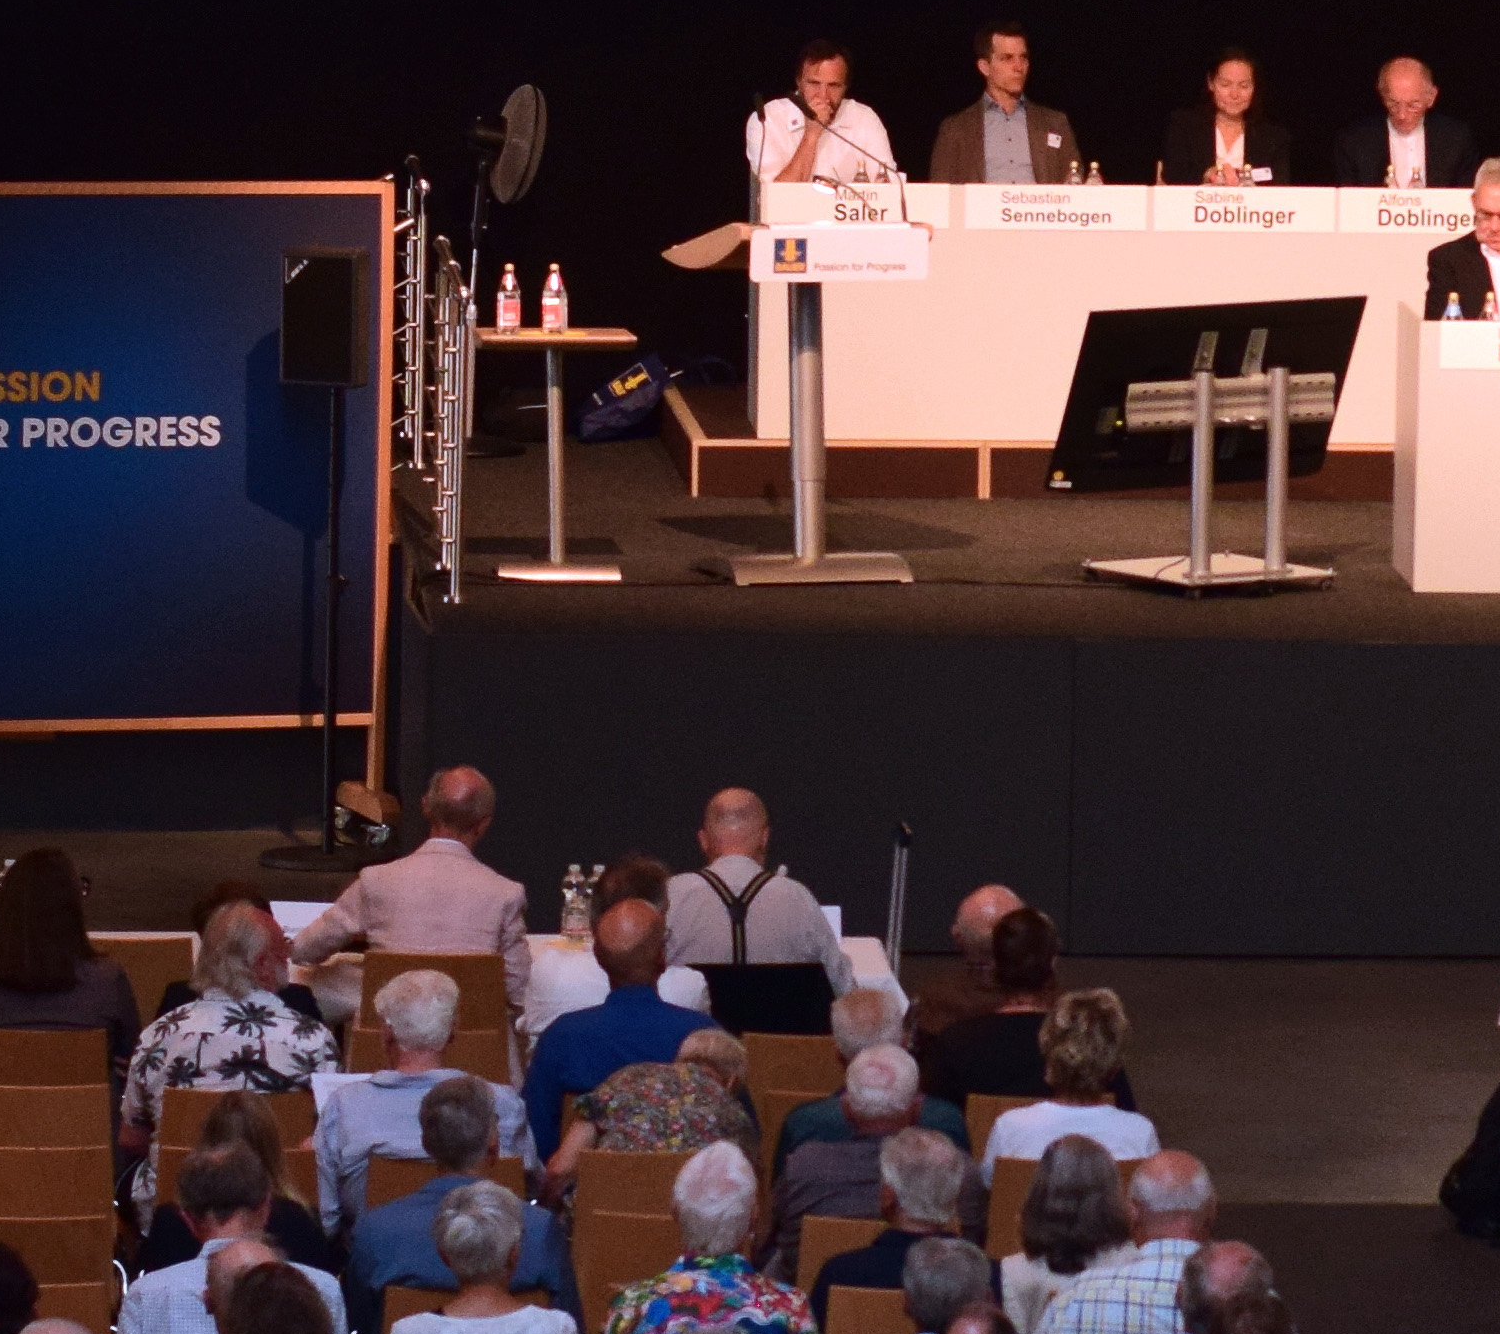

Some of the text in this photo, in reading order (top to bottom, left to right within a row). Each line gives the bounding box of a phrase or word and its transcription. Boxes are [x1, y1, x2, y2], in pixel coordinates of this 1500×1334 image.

[1001, 191, 1071, 205] Sebastian
[1194, 190, 1244, 205] Sabine
[1378, 193, 1422, 207] Alfons
[834, 203, 888, 222] Saler
[1001, 208, 1112, 227] Sennebogen
[1194, 205, 1296, 228] Doblinger
[22, 414, 221, 449] PROGRESS
